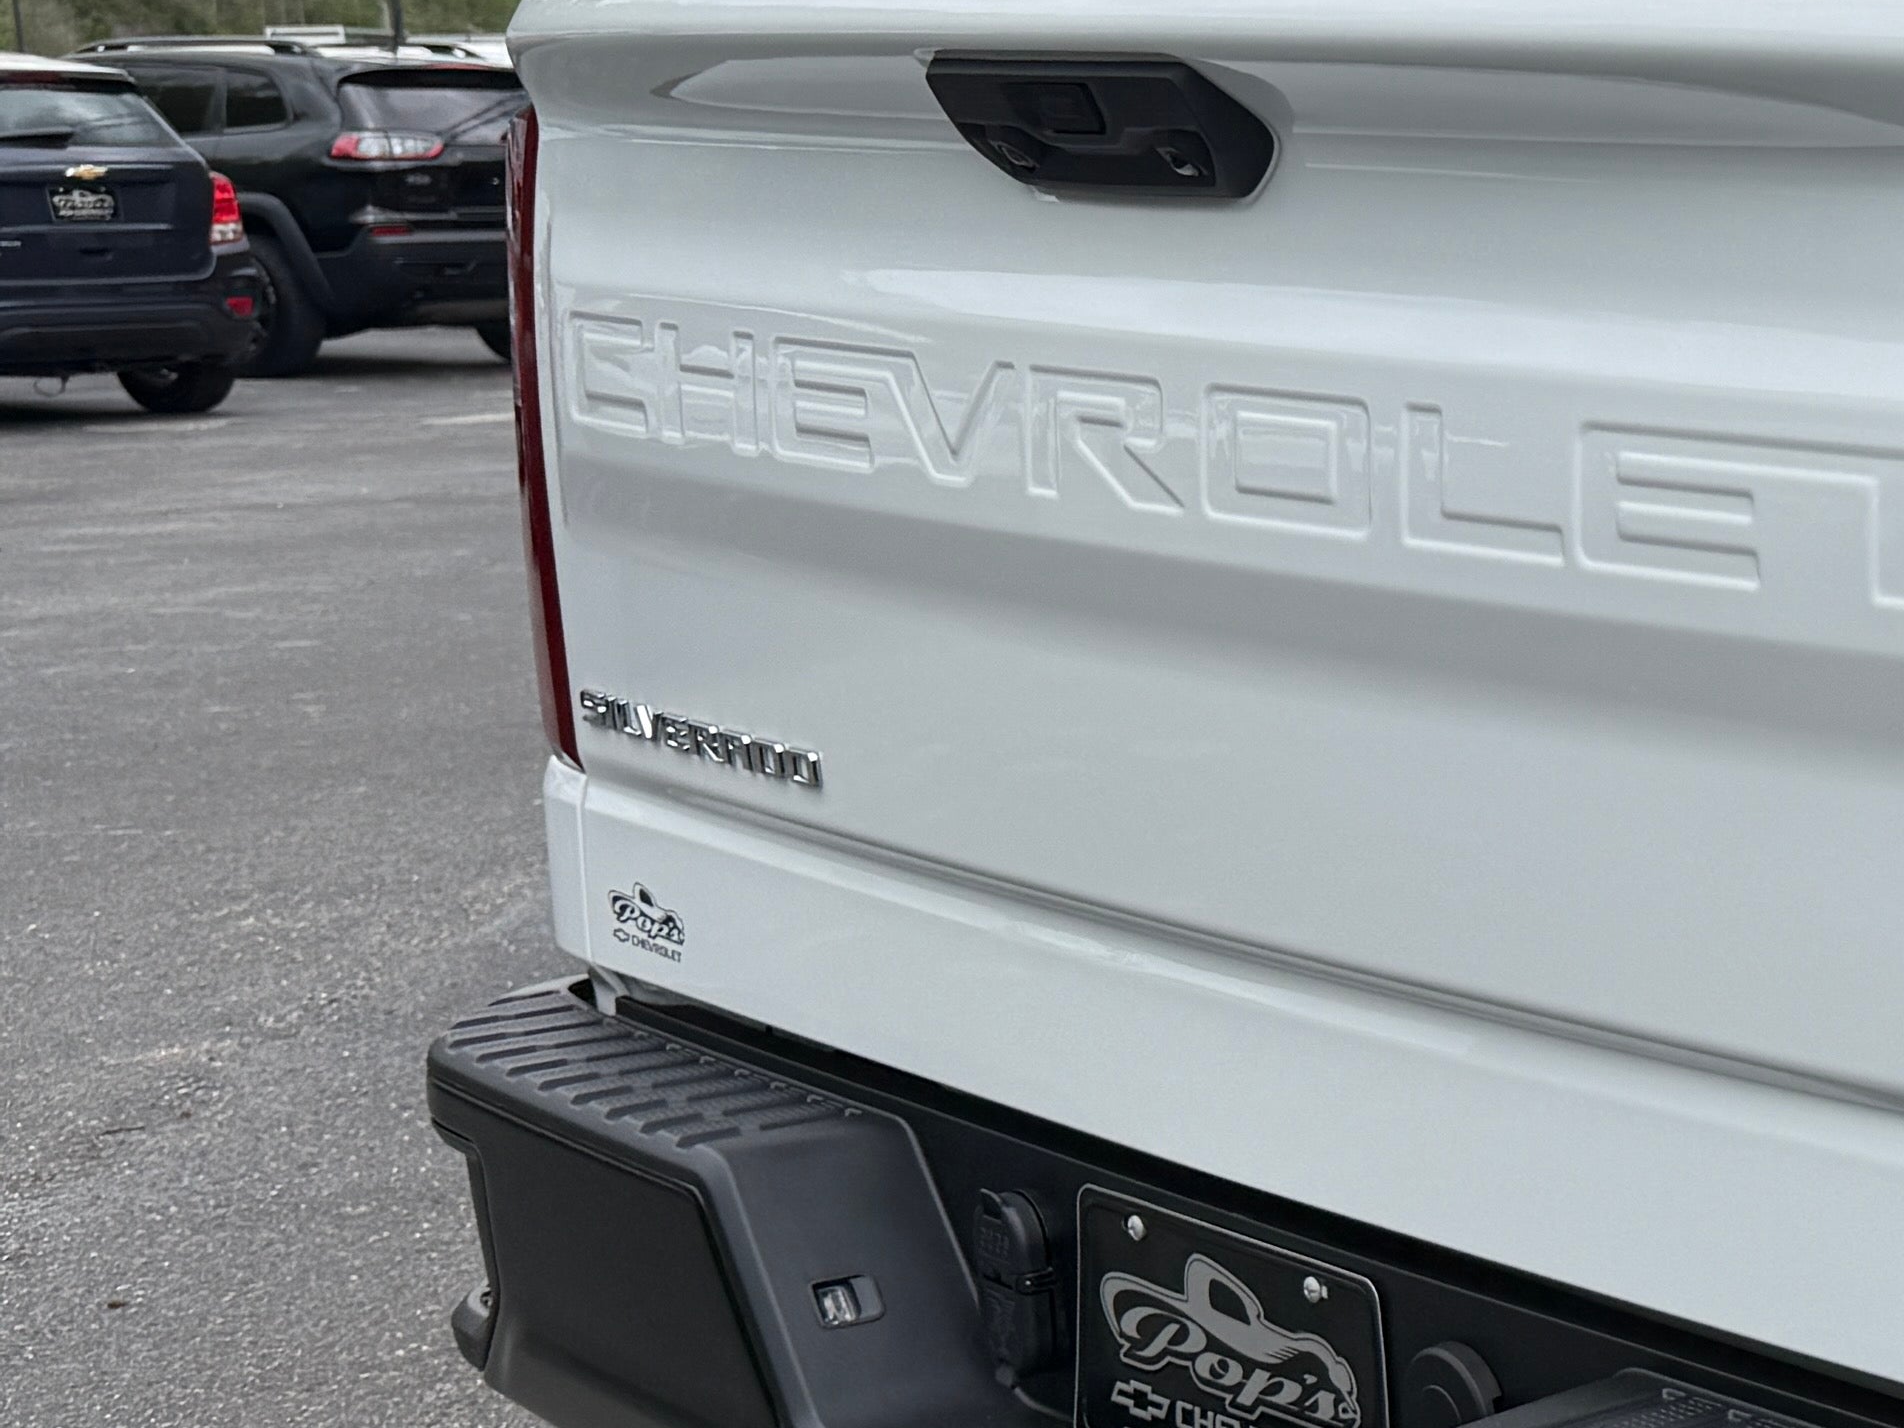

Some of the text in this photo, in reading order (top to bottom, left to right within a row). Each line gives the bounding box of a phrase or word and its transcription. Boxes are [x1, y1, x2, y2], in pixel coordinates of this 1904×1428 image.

[579, 688, 824, 788] SILVERADO
[631, 934, 682, 963] CHEVROLET
[1119, 1305, 1357, 1428] Pop's
